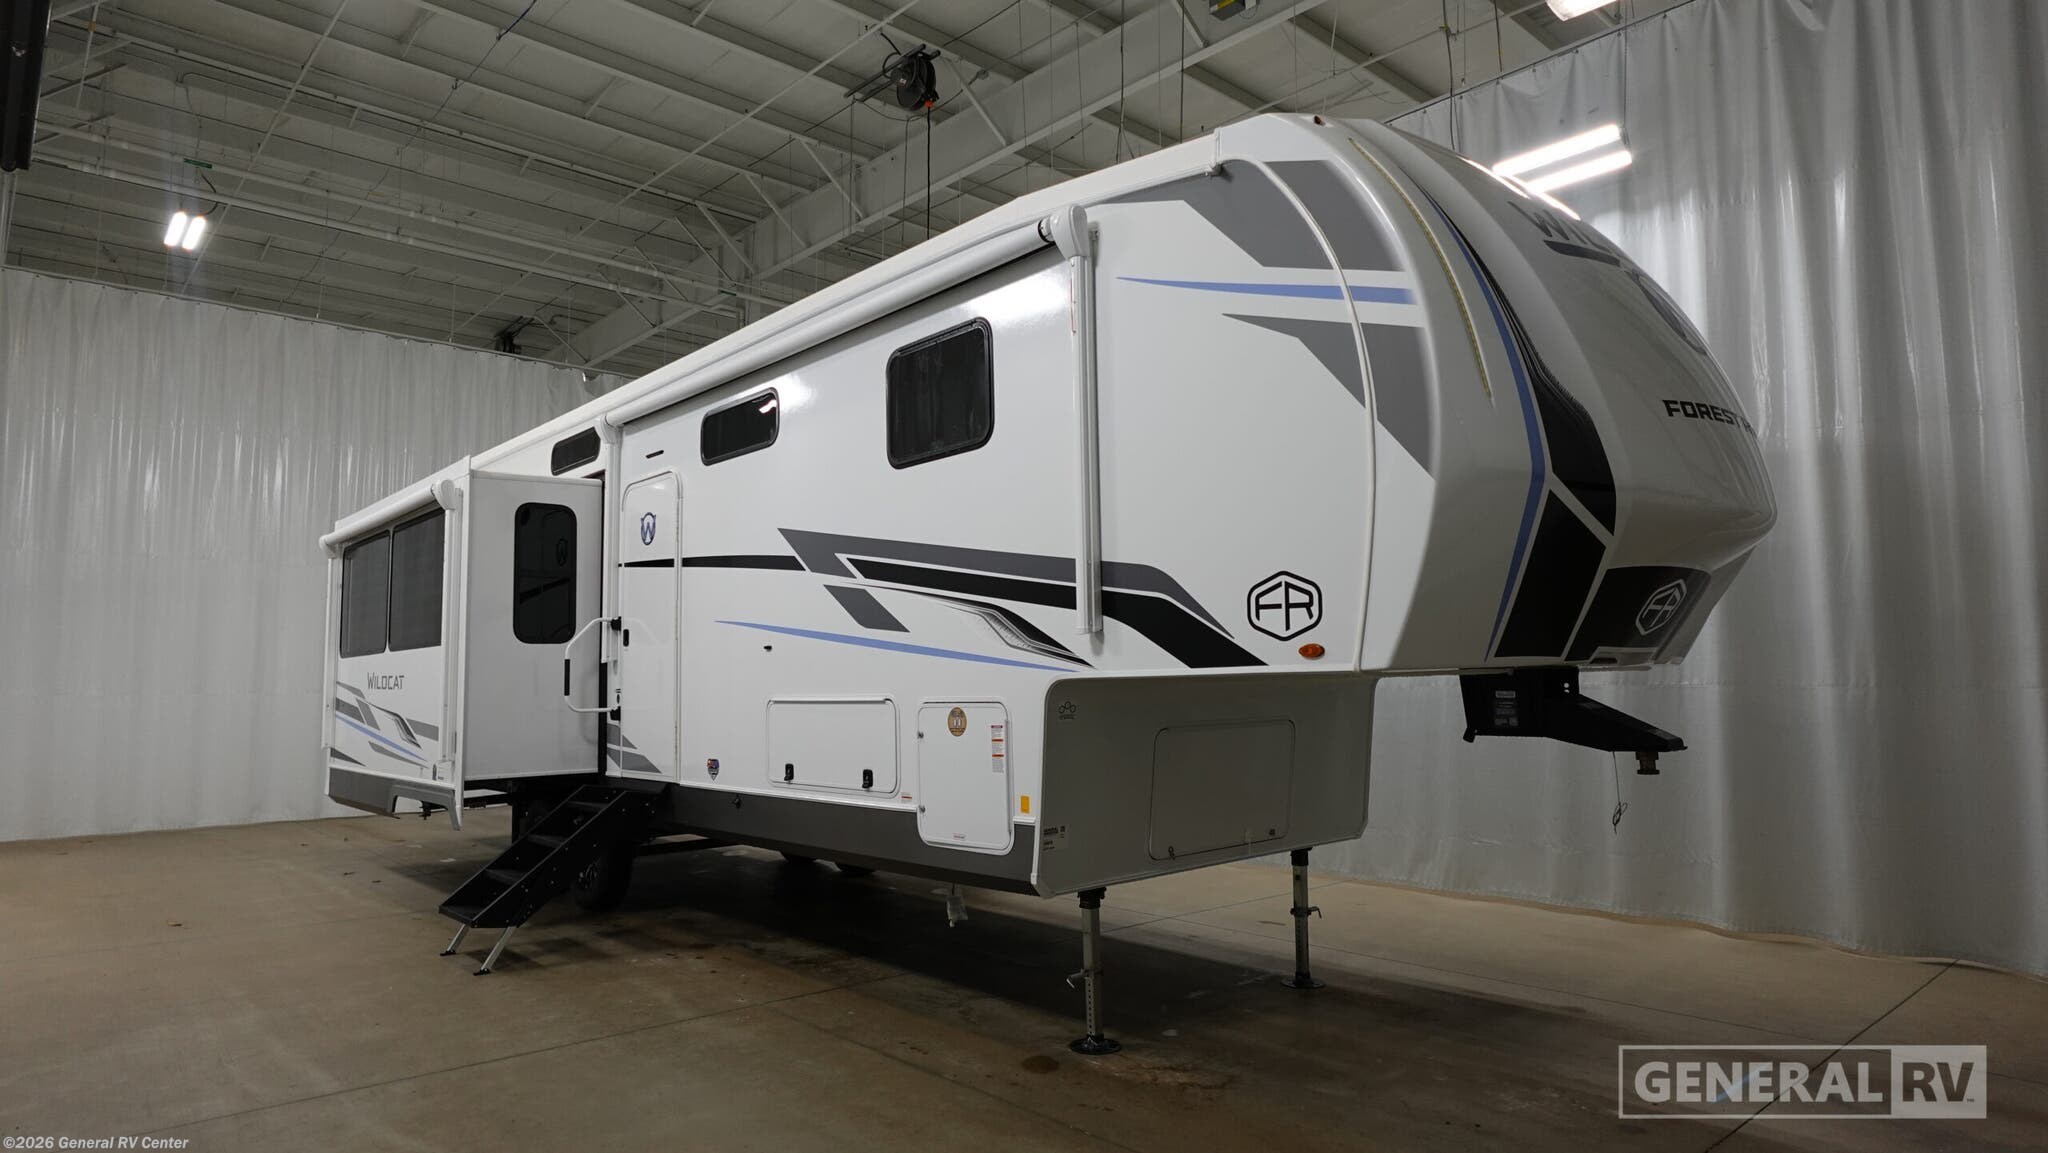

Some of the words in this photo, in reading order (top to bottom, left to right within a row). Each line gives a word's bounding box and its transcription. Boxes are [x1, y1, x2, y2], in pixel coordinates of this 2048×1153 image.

[1662, 400, 1741, 428] FOREST
[1255, 580, 1314, 631] FR
[367, 672, 405, 690] WILDCAT
